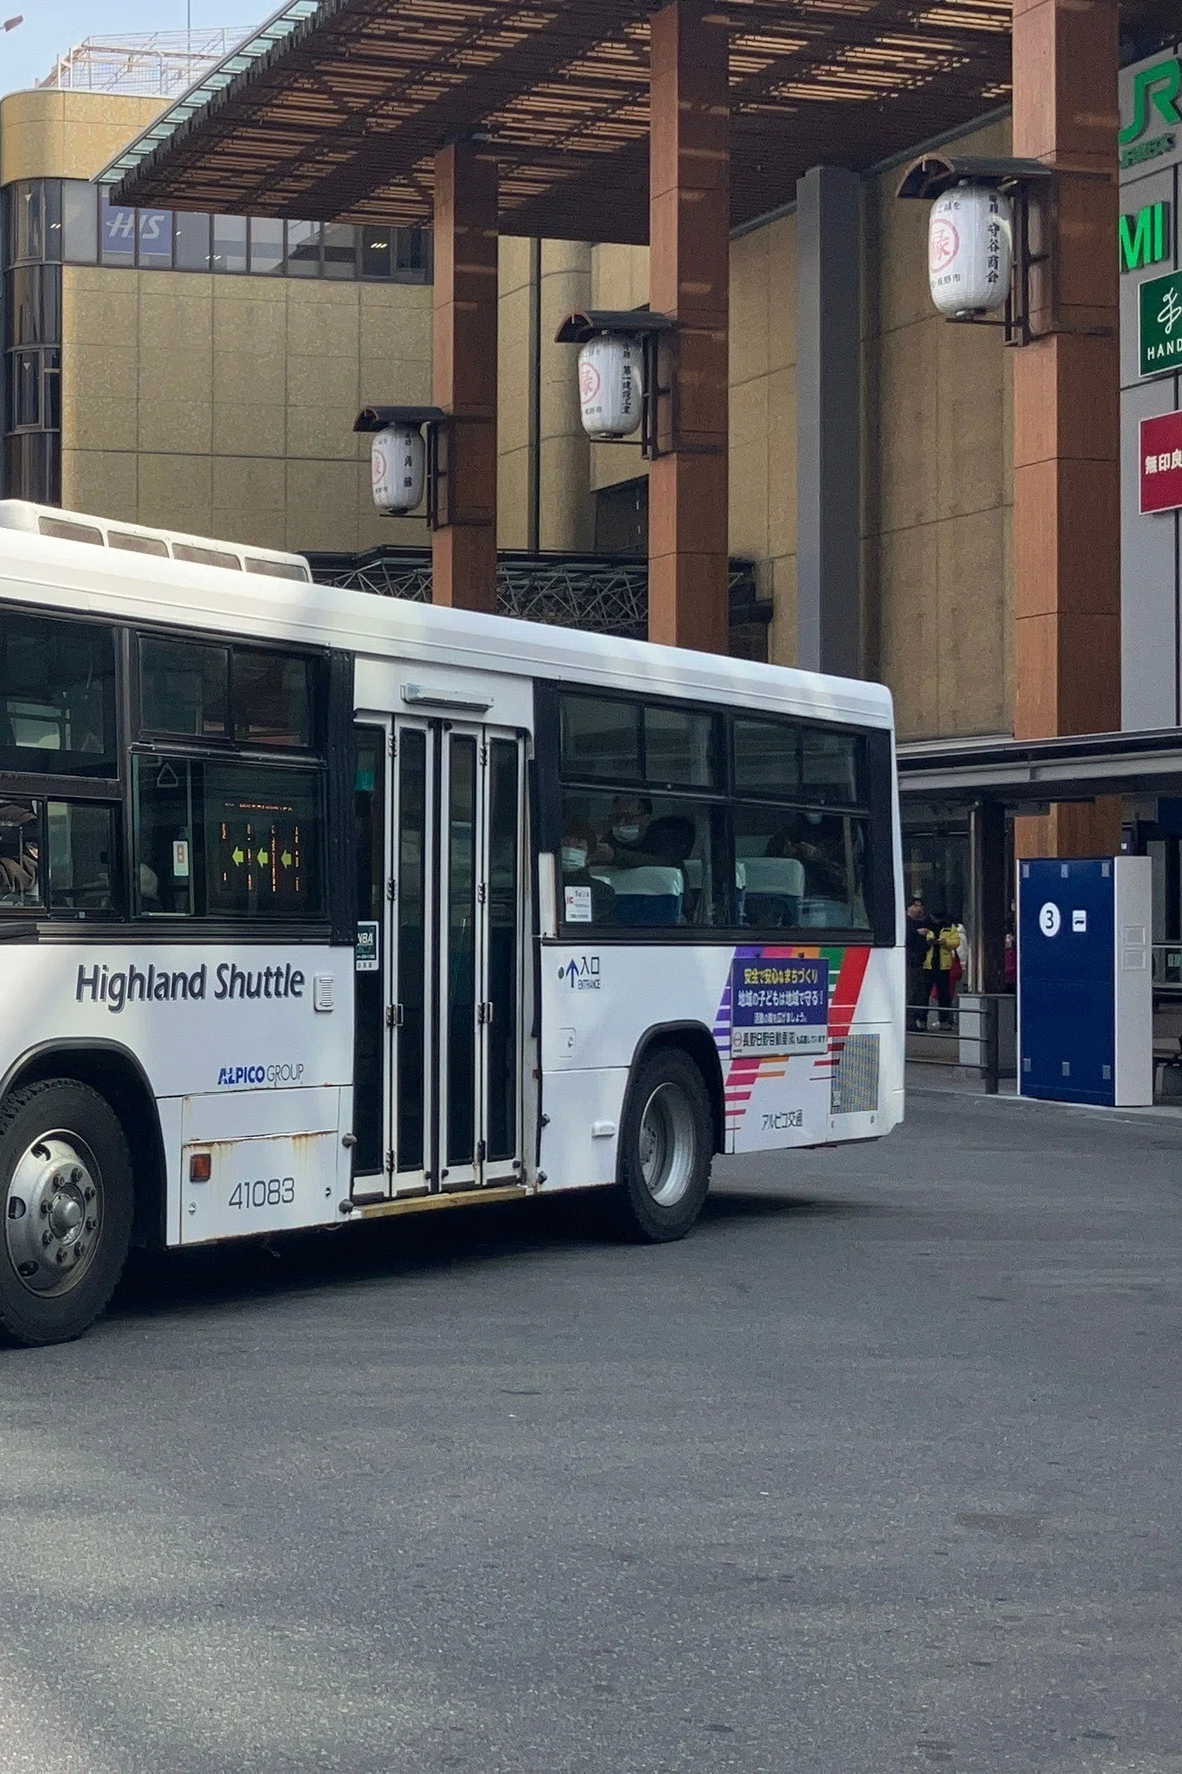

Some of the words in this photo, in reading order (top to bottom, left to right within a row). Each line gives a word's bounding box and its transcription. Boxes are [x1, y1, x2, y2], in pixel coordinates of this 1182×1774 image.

[1119, 58, 1180, 145] JR
[1045, 909, 1054, 930] 3
[580, 956, 600, 976] 入口
[75, 963, 208, 1014] Highland
[214, 962, 306, 999] Shuttle
[217, 1065, 265, 1085] ALPICO
[266, 1063, 304, 1082] GROUP
[761, 1108, 803, 1131] アルピコ交通
[228, 1176, 295, 1209] 41083
